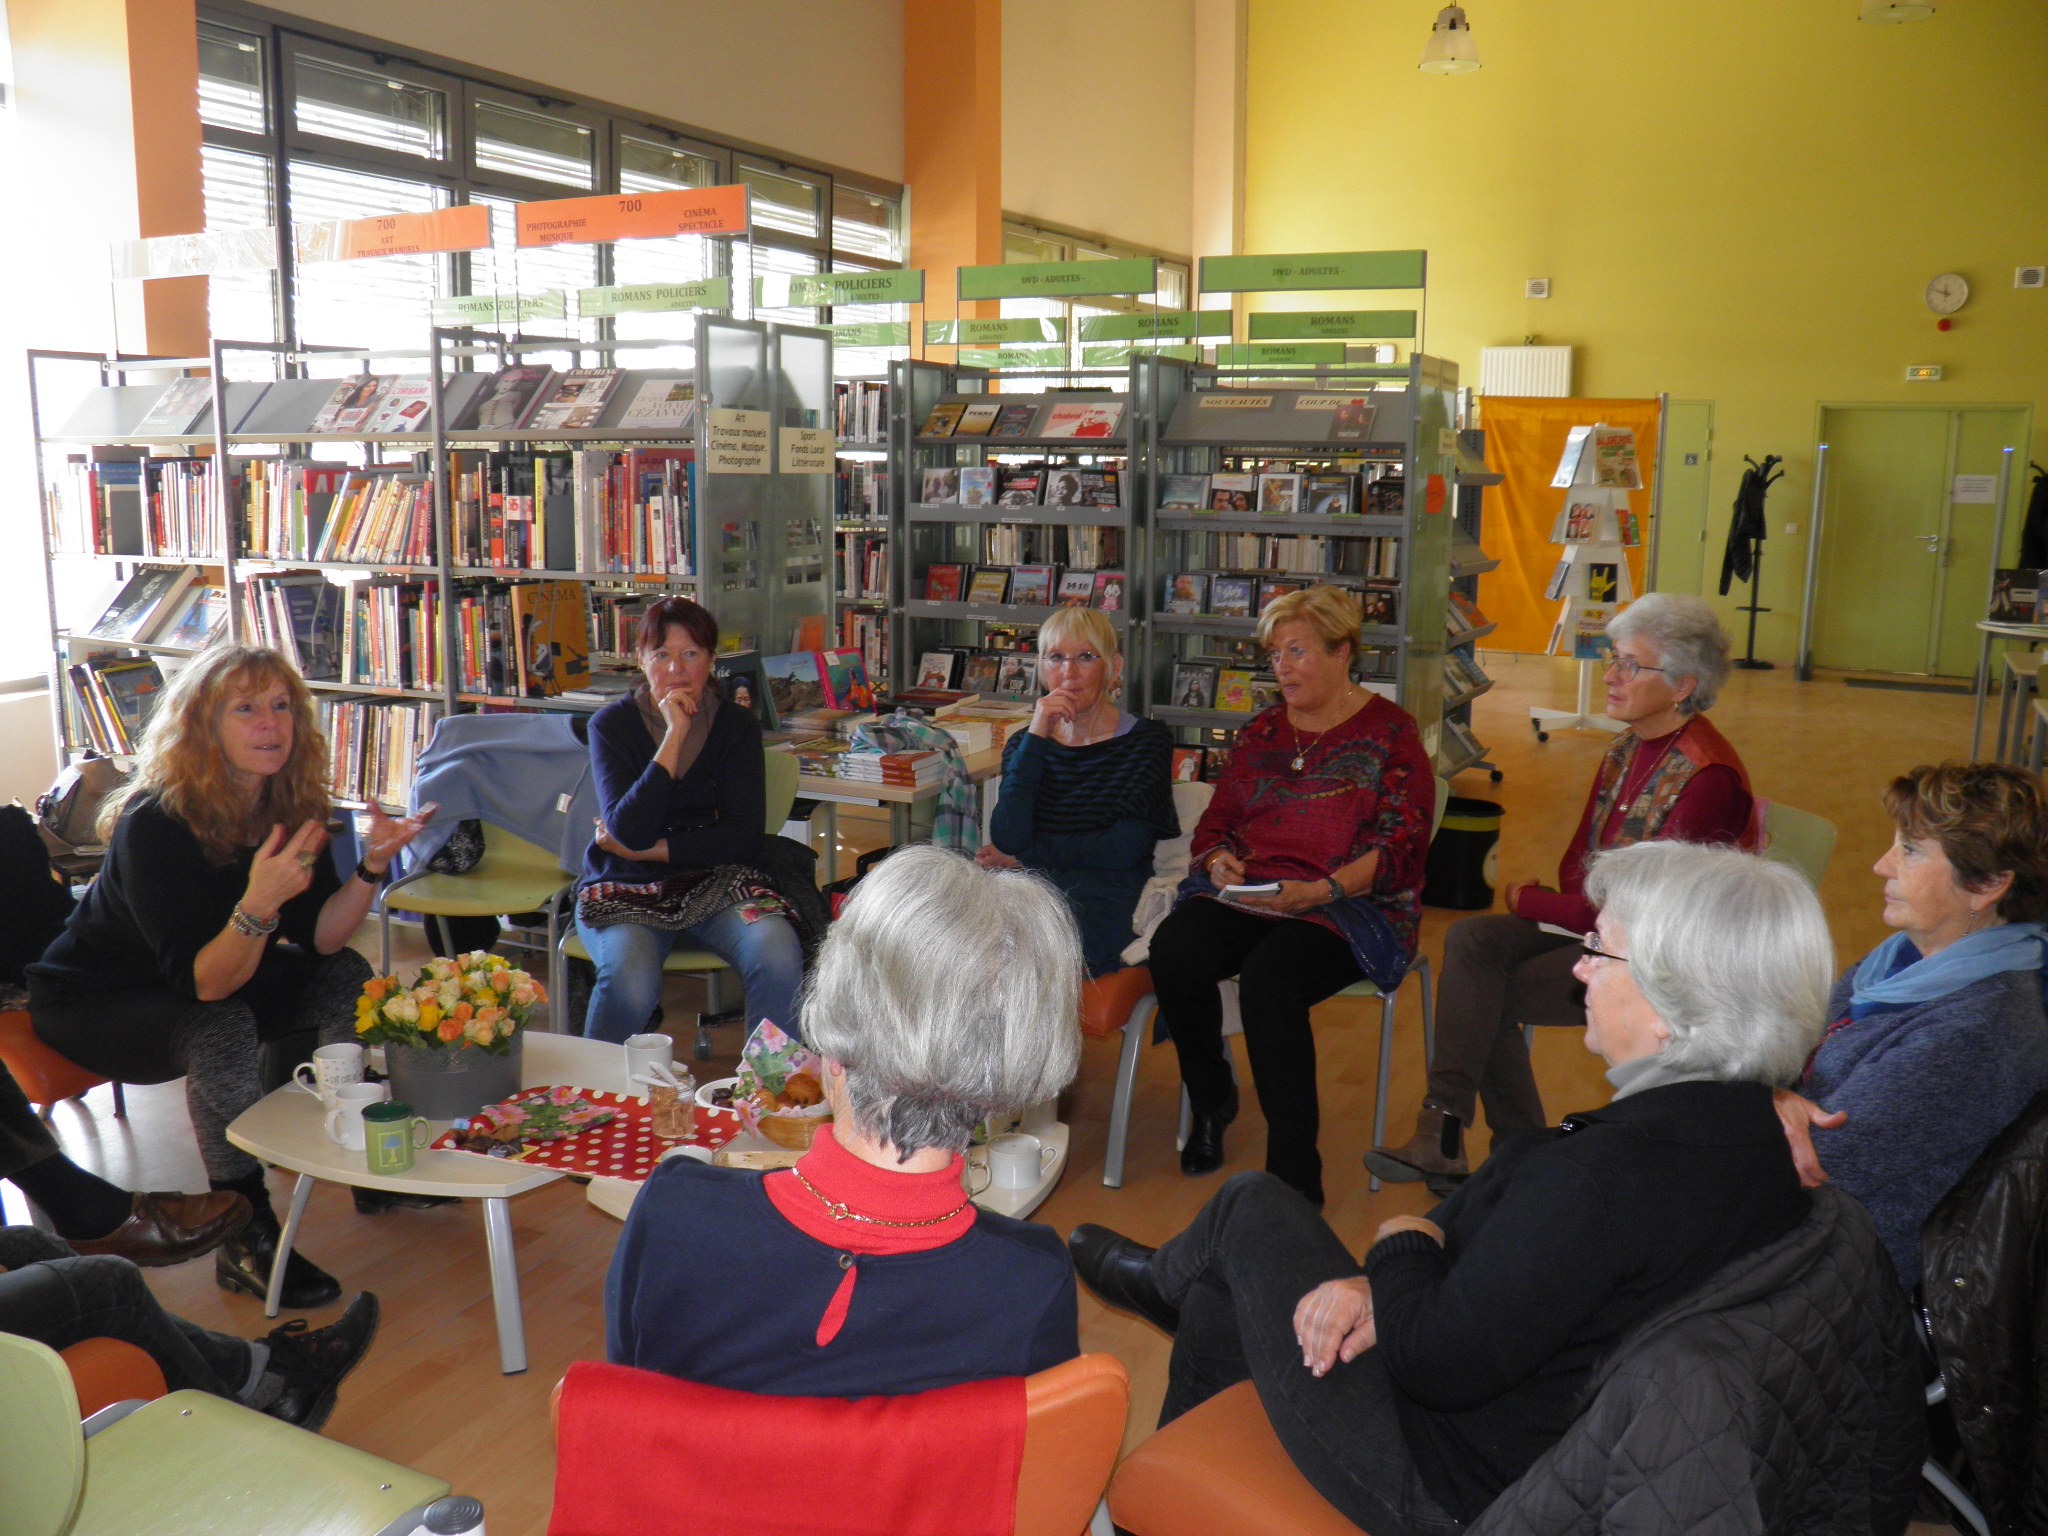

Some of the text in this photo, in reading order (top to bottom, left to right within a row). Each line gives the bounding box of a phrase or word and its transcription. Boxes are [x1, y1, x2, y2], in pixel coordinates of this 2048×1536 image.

[618, 199, 642, 213] 700
[683, 207, 717, 219] CINEMA
[376, 218, 396, 230] 700
[526, 218, 587, 232] PHOTOGRAPHIE
[678, 219, 724, 232] SPECTACLE
[380, 236, 394, 244] ART
[539, 231, 574, 243] MUSIQUE
[1272, 266, 1339, 276] DVD ADULTES
[834, 277, 892, 291] POLICIERS
[1021, 274, 1081, 284] DVD ADULTES
[611, 286, 707, 303] ROMANS POLICIERS
[458, 301, 494, 312] ROMANS
[1138, 317, 1179, 328] ROMANS
[1311, 316, 1355, 326] ROMANS
[970, 322, 1008, 332] ROMANS
[1262, 347, 1296, 356] ROMANS
[734, 412, 746, 422] Art
[712, 425, 767, 438] Travaux manuels
[800, 431, 816, 442] Sport
[790, 444, 825, 454] Fonds Local
[718, 455, 761, 467] Photographie
[1066, 582, 1089, 591] 14-18
[527, 588, 577, 605] CINEMA
